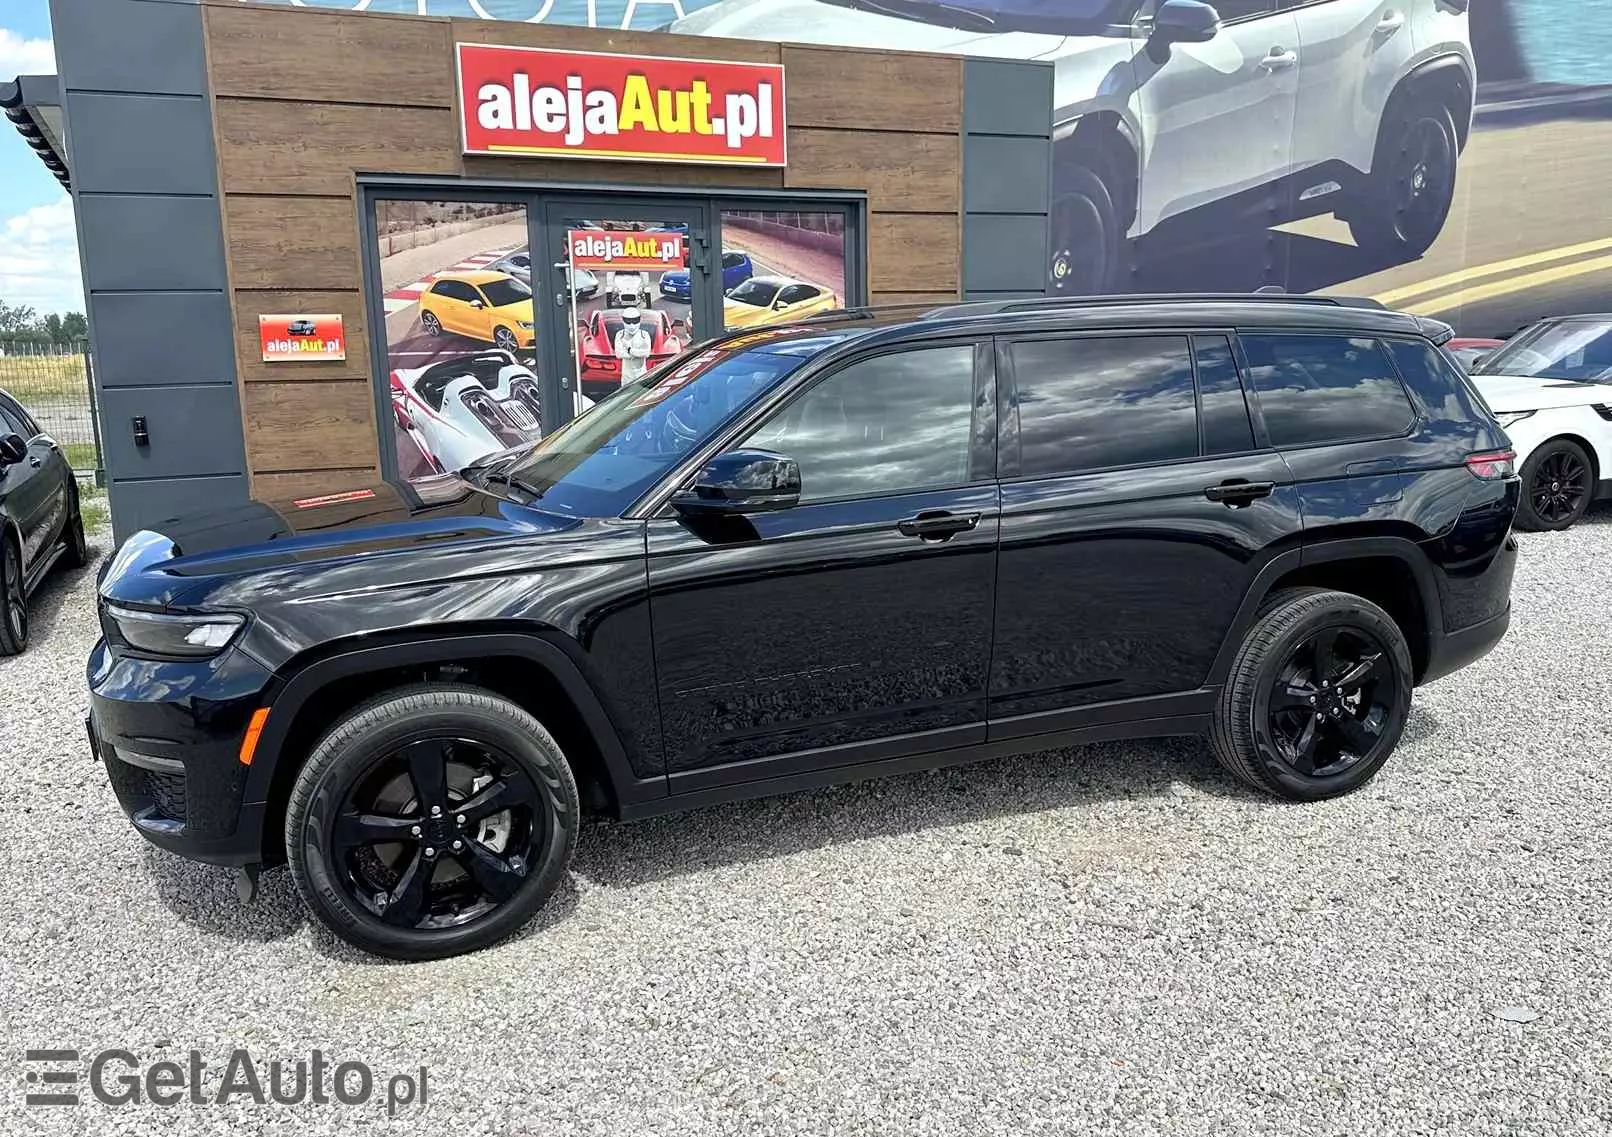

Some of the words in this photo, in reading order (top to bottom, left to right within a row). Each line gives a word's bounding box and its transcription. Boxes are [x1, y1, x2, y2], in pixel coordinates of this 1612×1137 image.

[476, 73, 773, 148] alejaAut.pl
[574, 236, 680, 262] alejaAut.pl
[266, 338, 340, 354] alejaAut.pl
